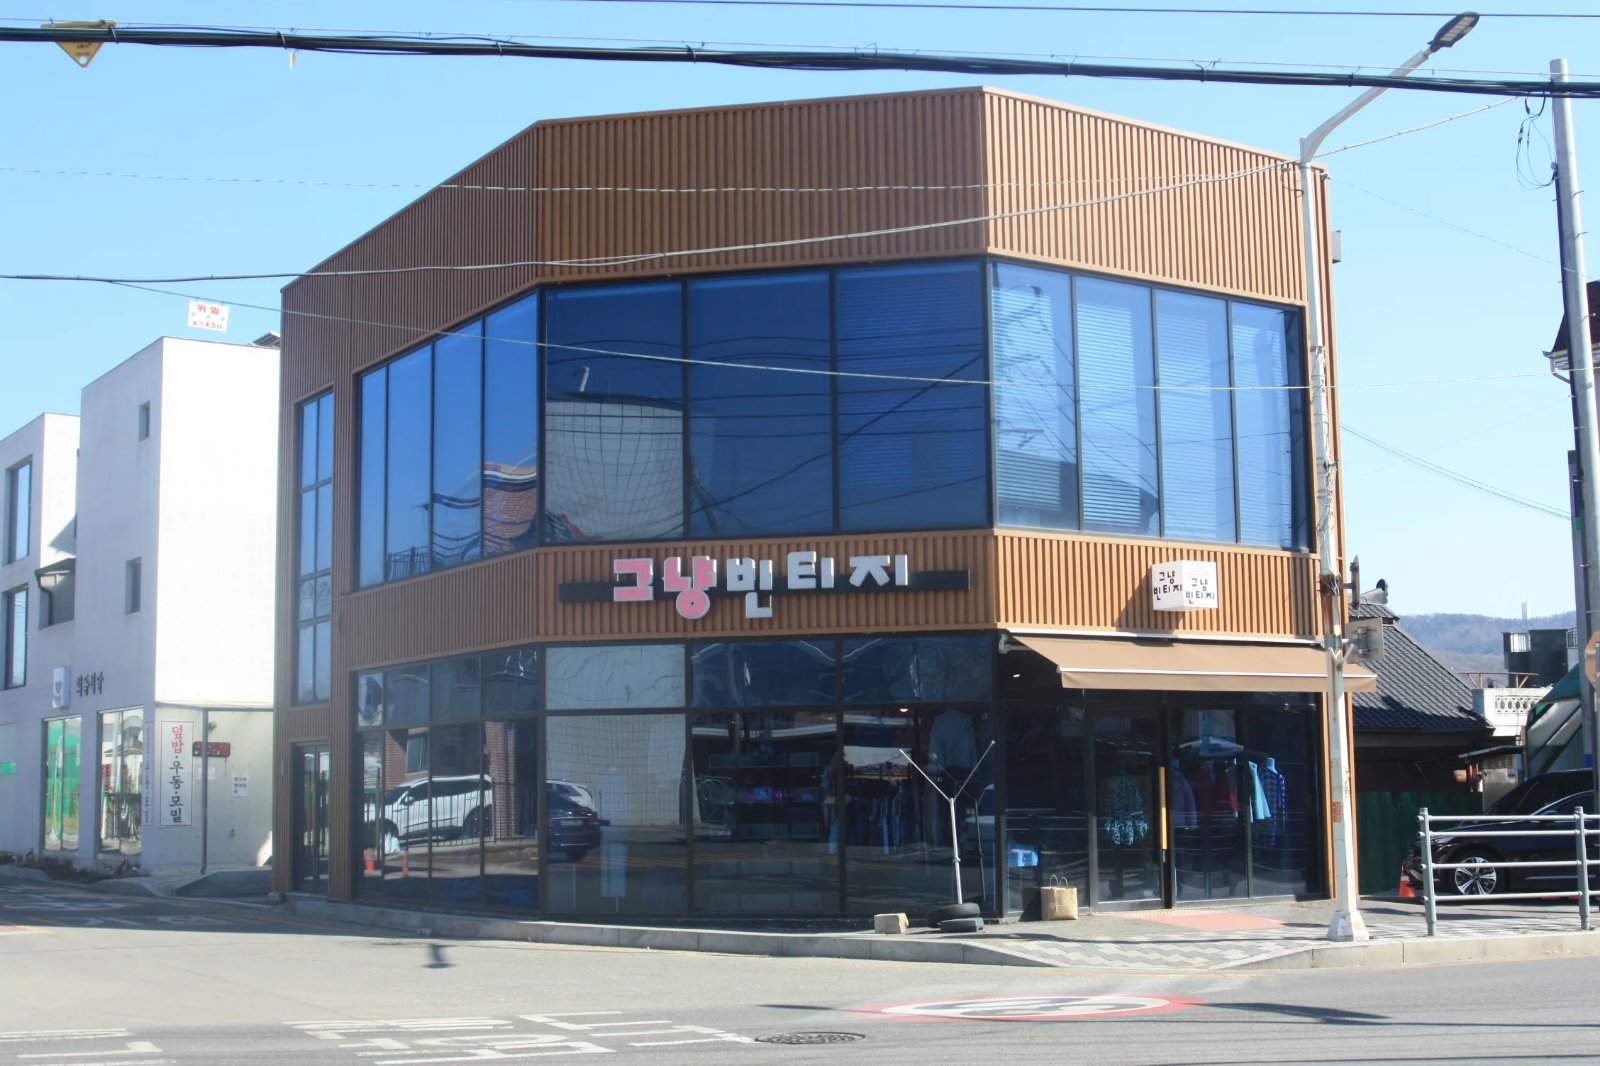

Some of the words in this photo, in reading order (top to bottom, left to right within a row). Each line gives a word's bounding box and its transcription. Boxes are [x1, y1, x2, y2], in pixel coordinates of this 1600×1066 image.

[1159, 570, 1175, 584] 그냥
[1191, 577, 1208, 591] 그냥
[1154, 584, 1182, 600] 빈티지
[1186, 590, 1215, 604] 빈티지
[912, 998, 1147, 1016] 30
